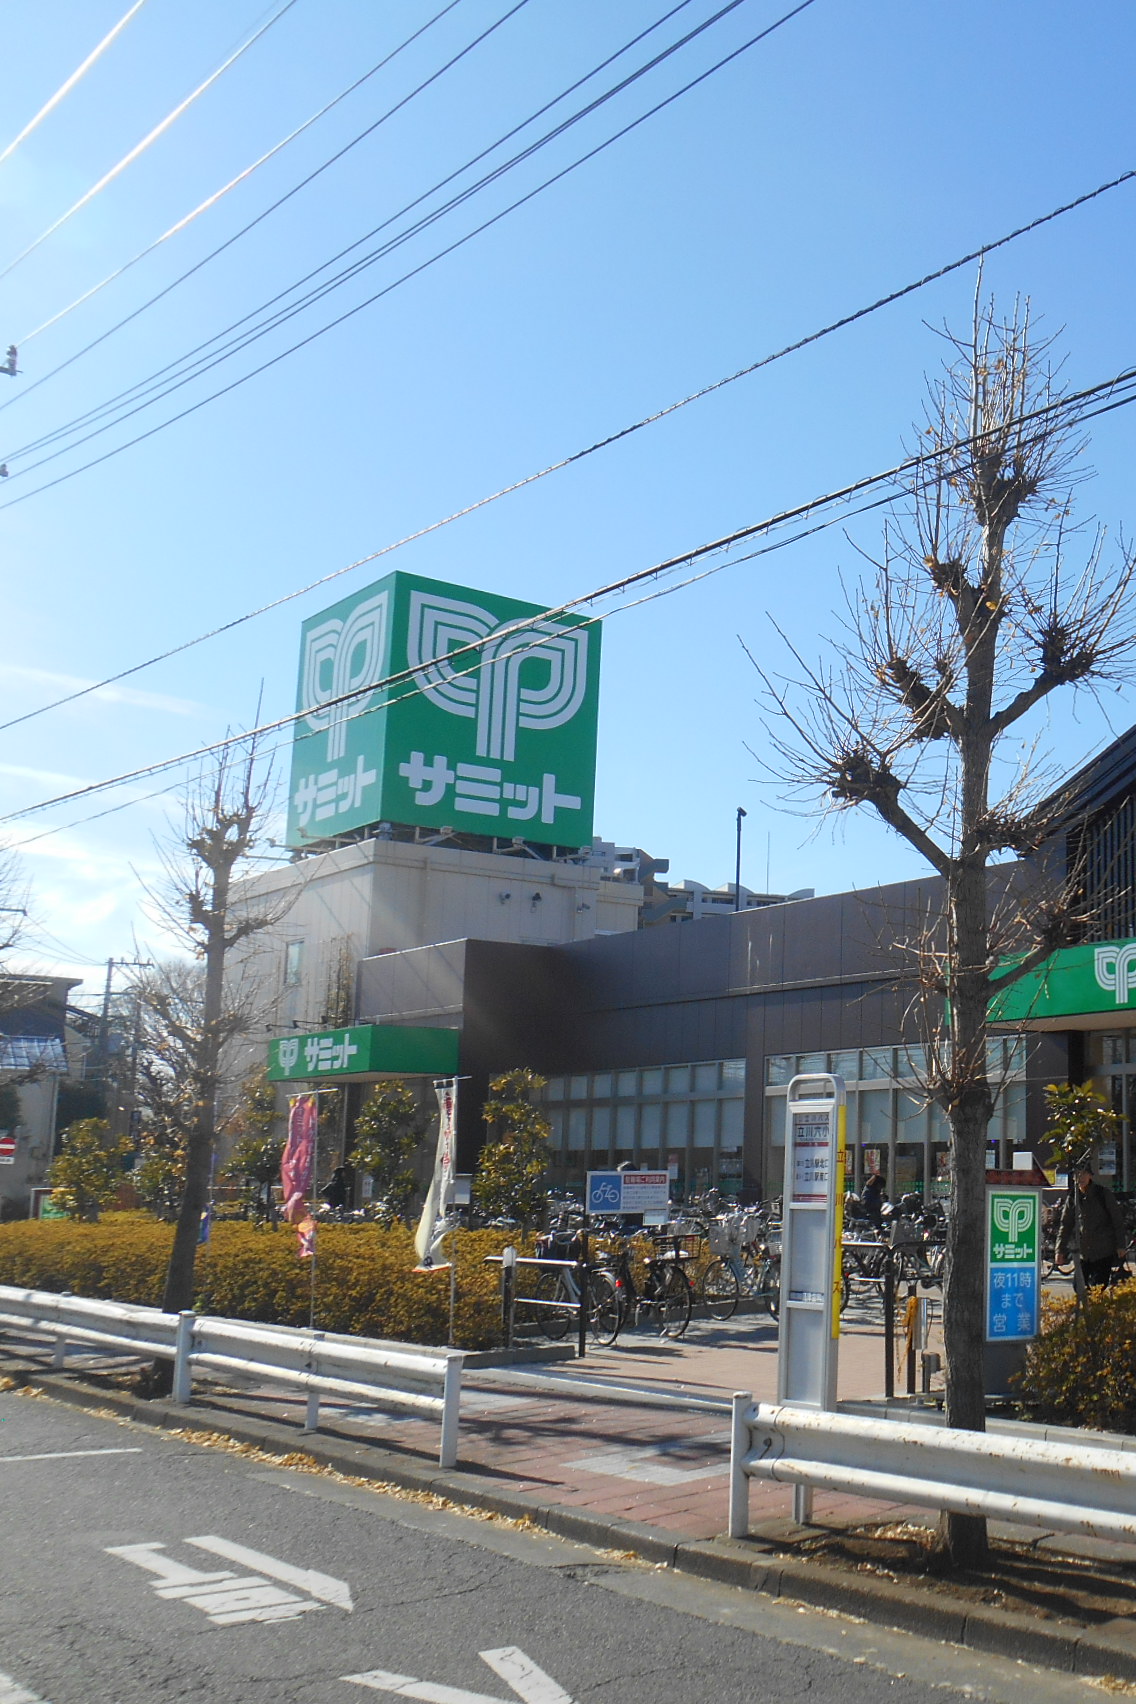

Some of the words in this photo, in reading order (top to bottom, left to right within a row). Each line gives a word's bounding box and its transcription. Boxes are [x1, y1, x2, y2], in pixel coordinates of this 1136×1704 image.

[294, 755, 377, 826] サミット
[399, 751, 581, 824] サミット
[304, 1033, 357, 1071] サミット
[993, 1243, 1033, 1259] サミット
[993, 1272, 1032, 1289] 夜11時
[1001, 1293, 1024, 1309] まで
[993, 1312, 1031, 1332] 営業
